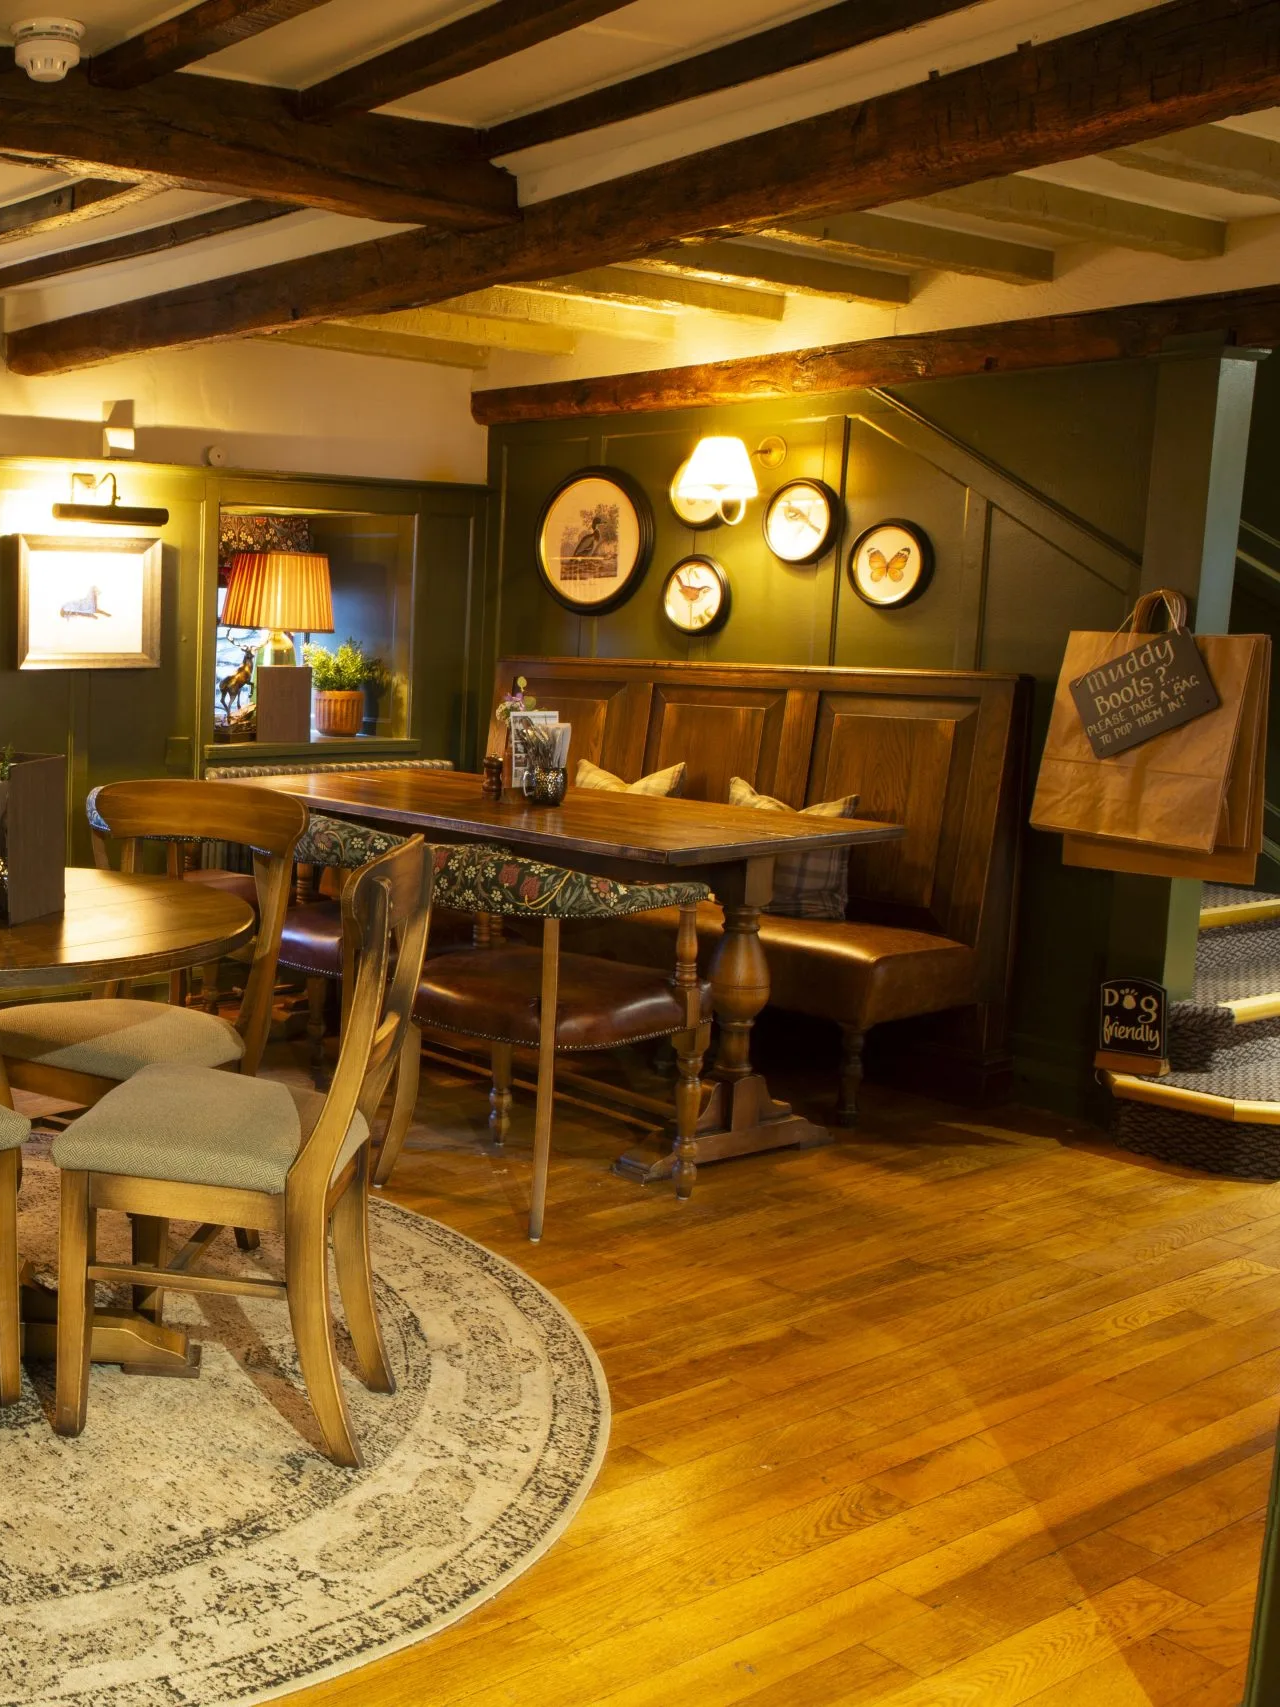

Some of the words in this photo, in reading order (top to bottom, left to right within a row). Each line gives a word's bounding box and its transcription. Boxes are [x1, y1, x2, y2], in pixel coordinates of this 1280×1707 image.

[1087, 709, 1127, 737] PLEASE
[1129, 695, 1157, 716] TAKE
[1160, 690, 1169, 702] A
[1173, 675, 1200, 695] BAG
[1100, 735, 1112, 746] TO
[1113, 722, 1133, 739] POP
[1135, 709, 1164, 728] THEM
[1167, 695, 1187, 713] IN!
[1103, 1014, 1160, 1051] friendly
